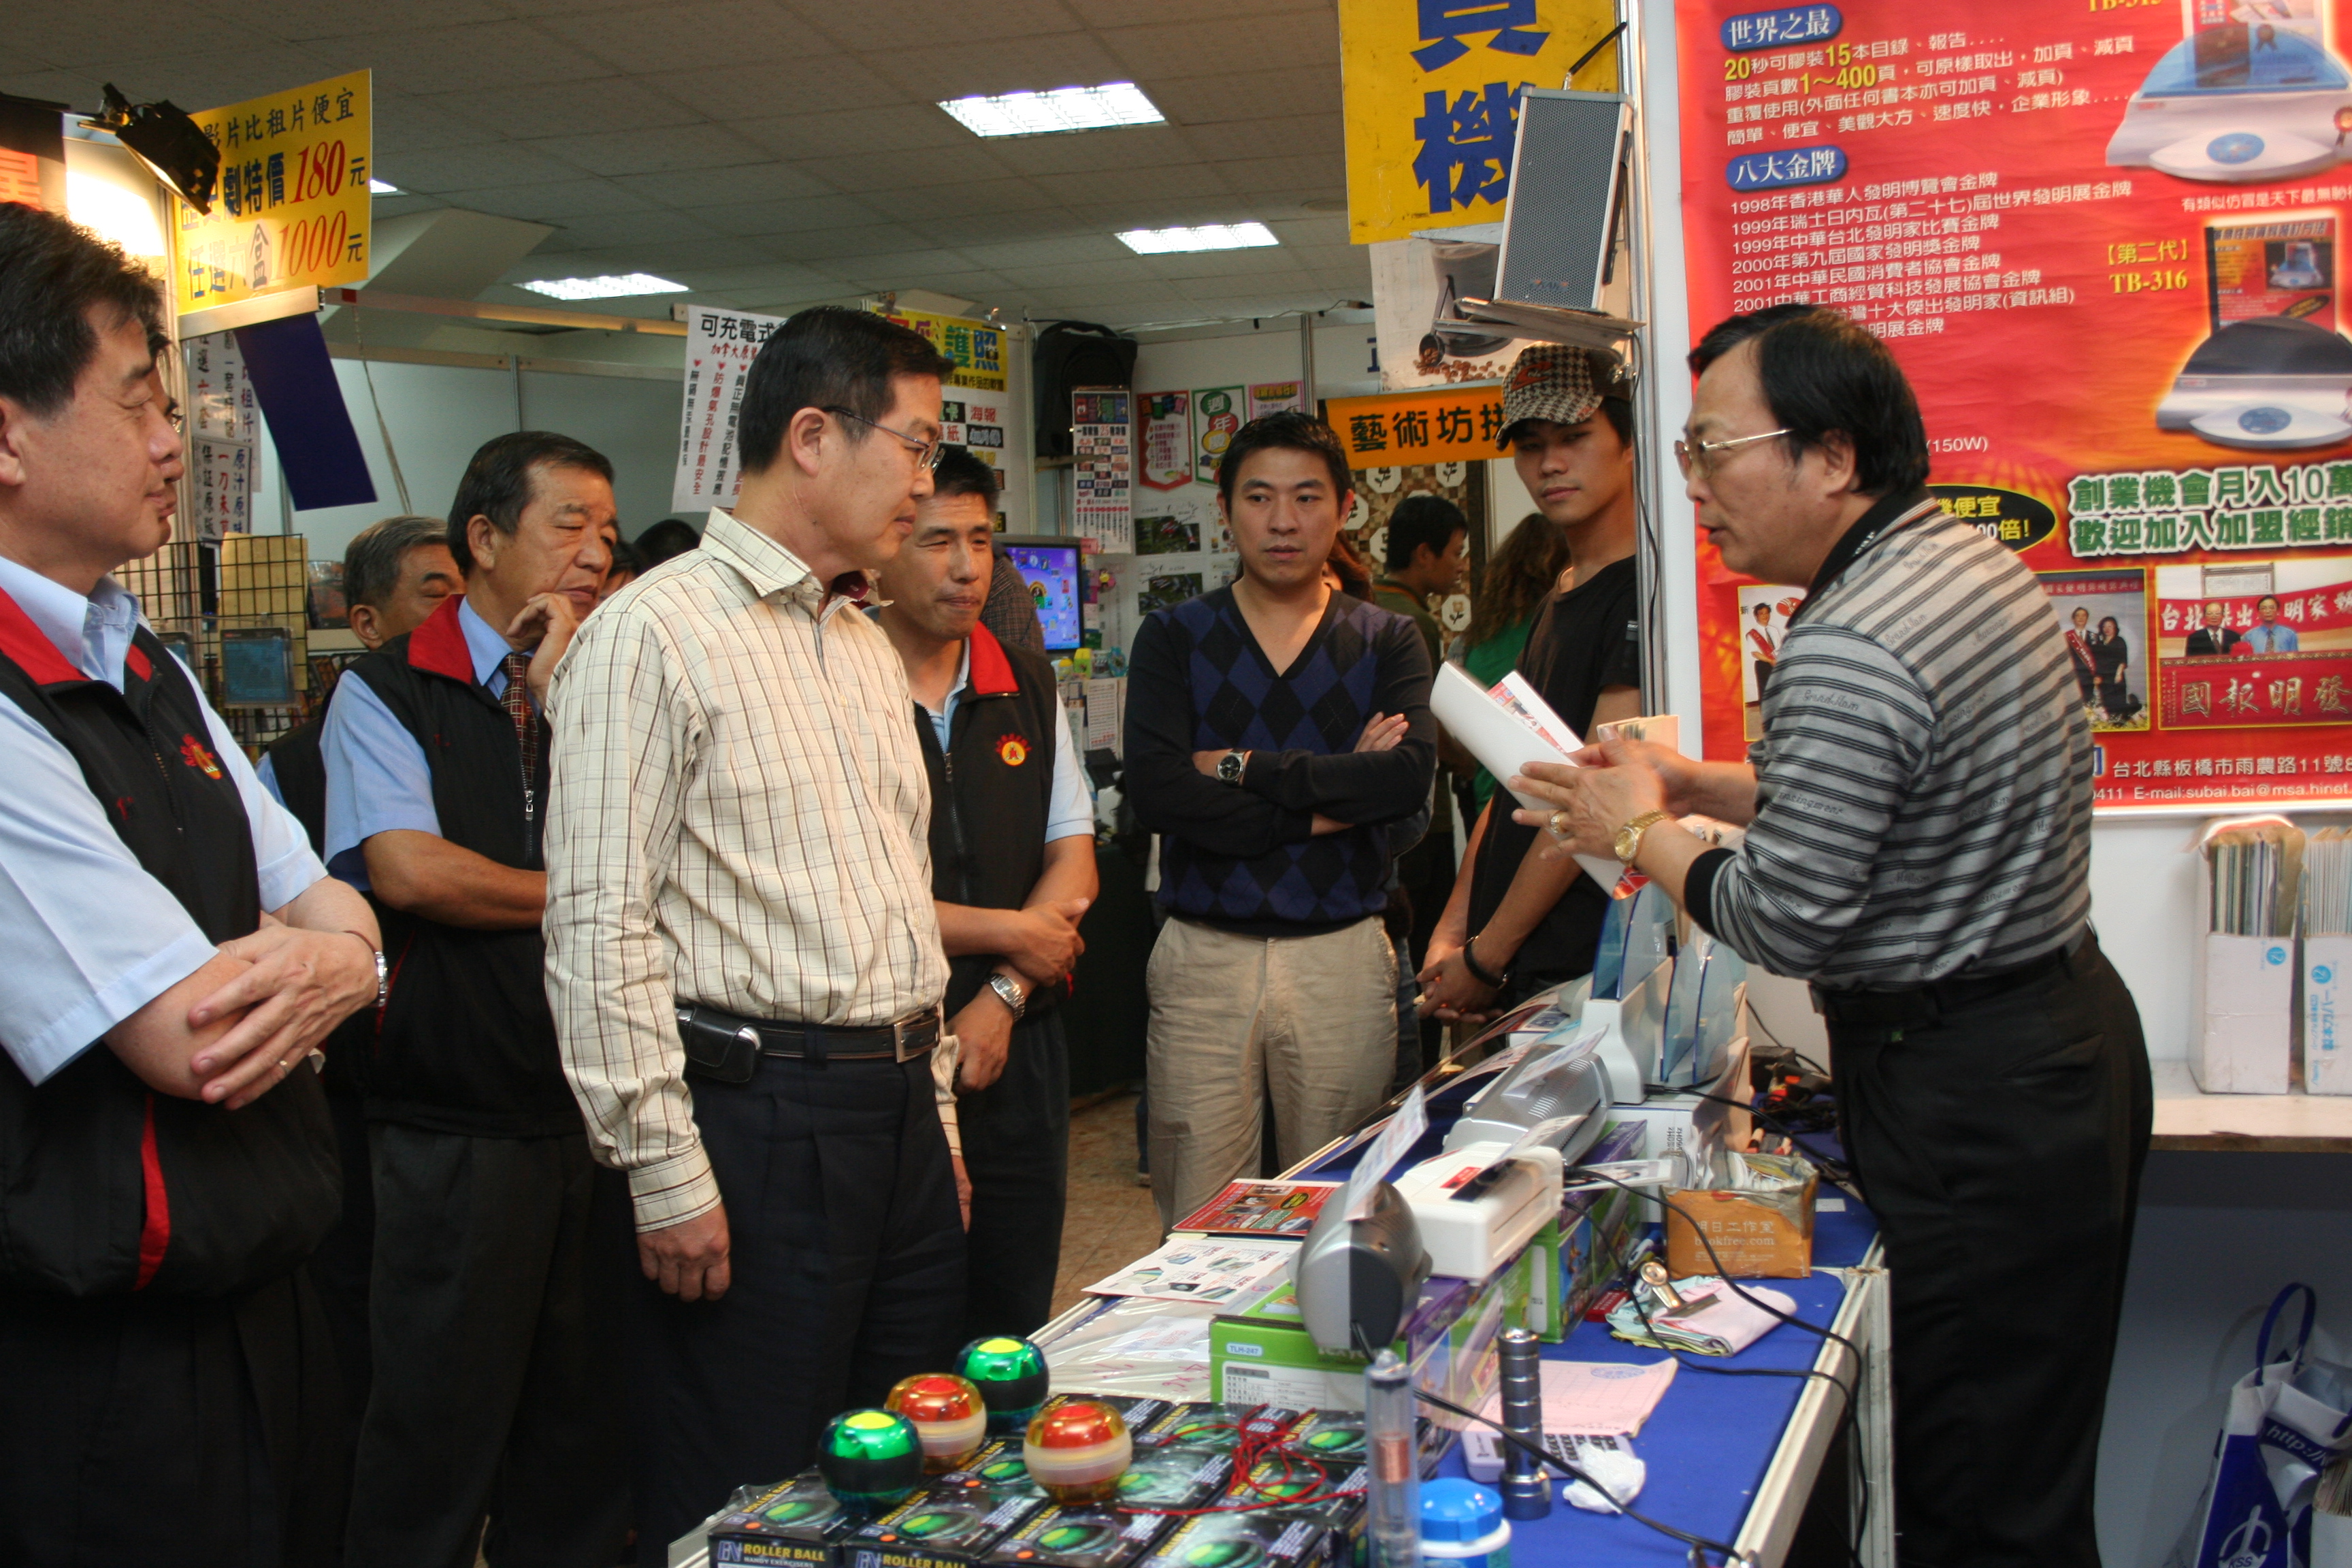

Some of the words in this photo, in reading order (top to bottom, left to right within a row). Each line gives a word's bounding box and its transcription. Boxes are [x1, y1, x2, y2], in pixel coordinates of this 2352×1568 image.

[1728, 8, 1829, 47] 世界之最
[1735, 149, 1836, 184] 八大金牌
[1731, 172, 1998, 215] 1998年香港華人發明博覽會金牌
[1733, 214, 1999, 255] 1999年中華台北發明家比賽金牌
[1732, 235, 1980, 274] 2000年第九屆國家發明獎金牌
[1733, 253, 2000, 293] 2001年中華民國消費者協會金牌
[2109, 270, 2188, 293] TB-316
[1926, 436, 1989, 456] (150W)
[2068, 460, 2352, 515] 創業機會月入10萬
[2069, 503, 2352, 557] 歡迎加入加盟經銷
[1695, 1236, 1775, 1246] bokfree.com
[1229, 1345, 1259, 1355] TLH-247
[743, 1543, 791, 1558] ROLLER
[794, 1548, 826, 1562] BALL
